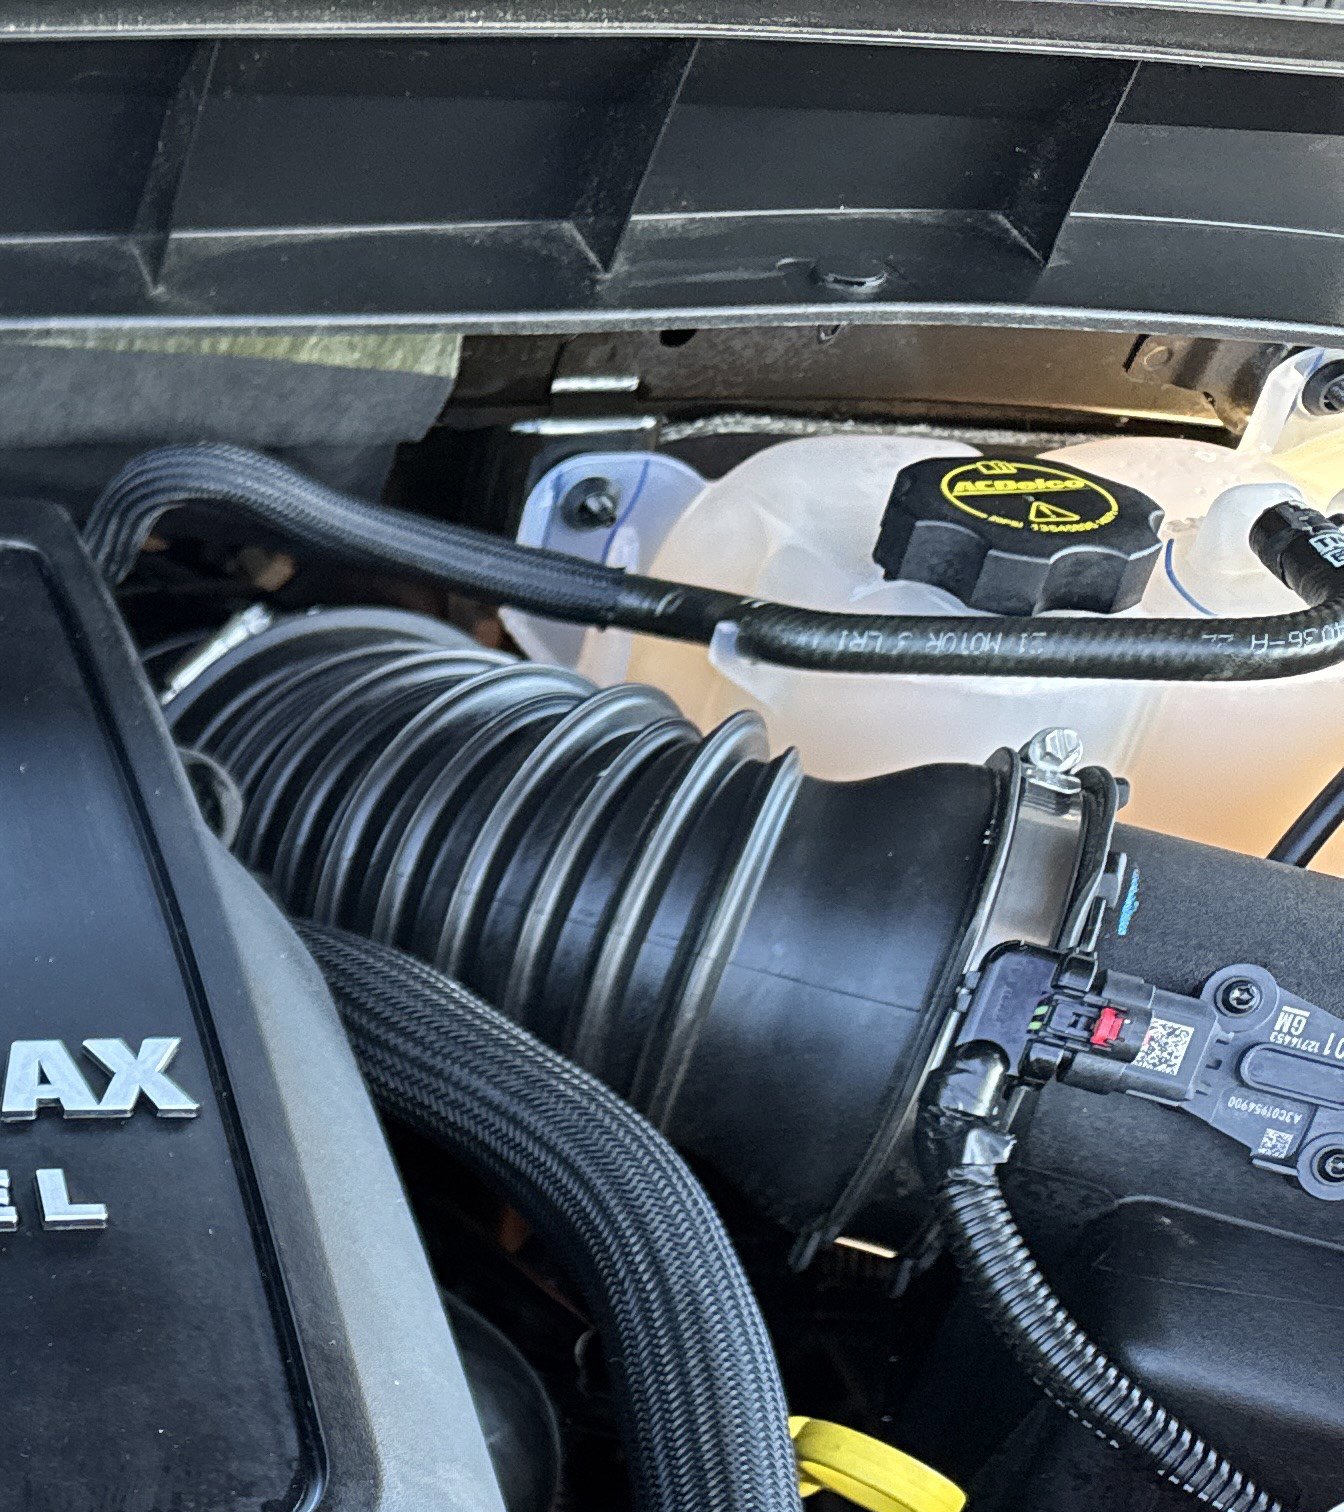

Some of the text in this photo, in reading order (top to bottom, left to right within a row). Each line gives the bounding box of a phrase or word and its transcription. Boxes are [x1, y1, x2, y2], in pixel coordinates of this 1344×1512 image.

[953, 478, 1087, 494] ACDelco
[927, 631, 1002, 656] MOTOR
[1274, 1008, 1308, 1036] GM
